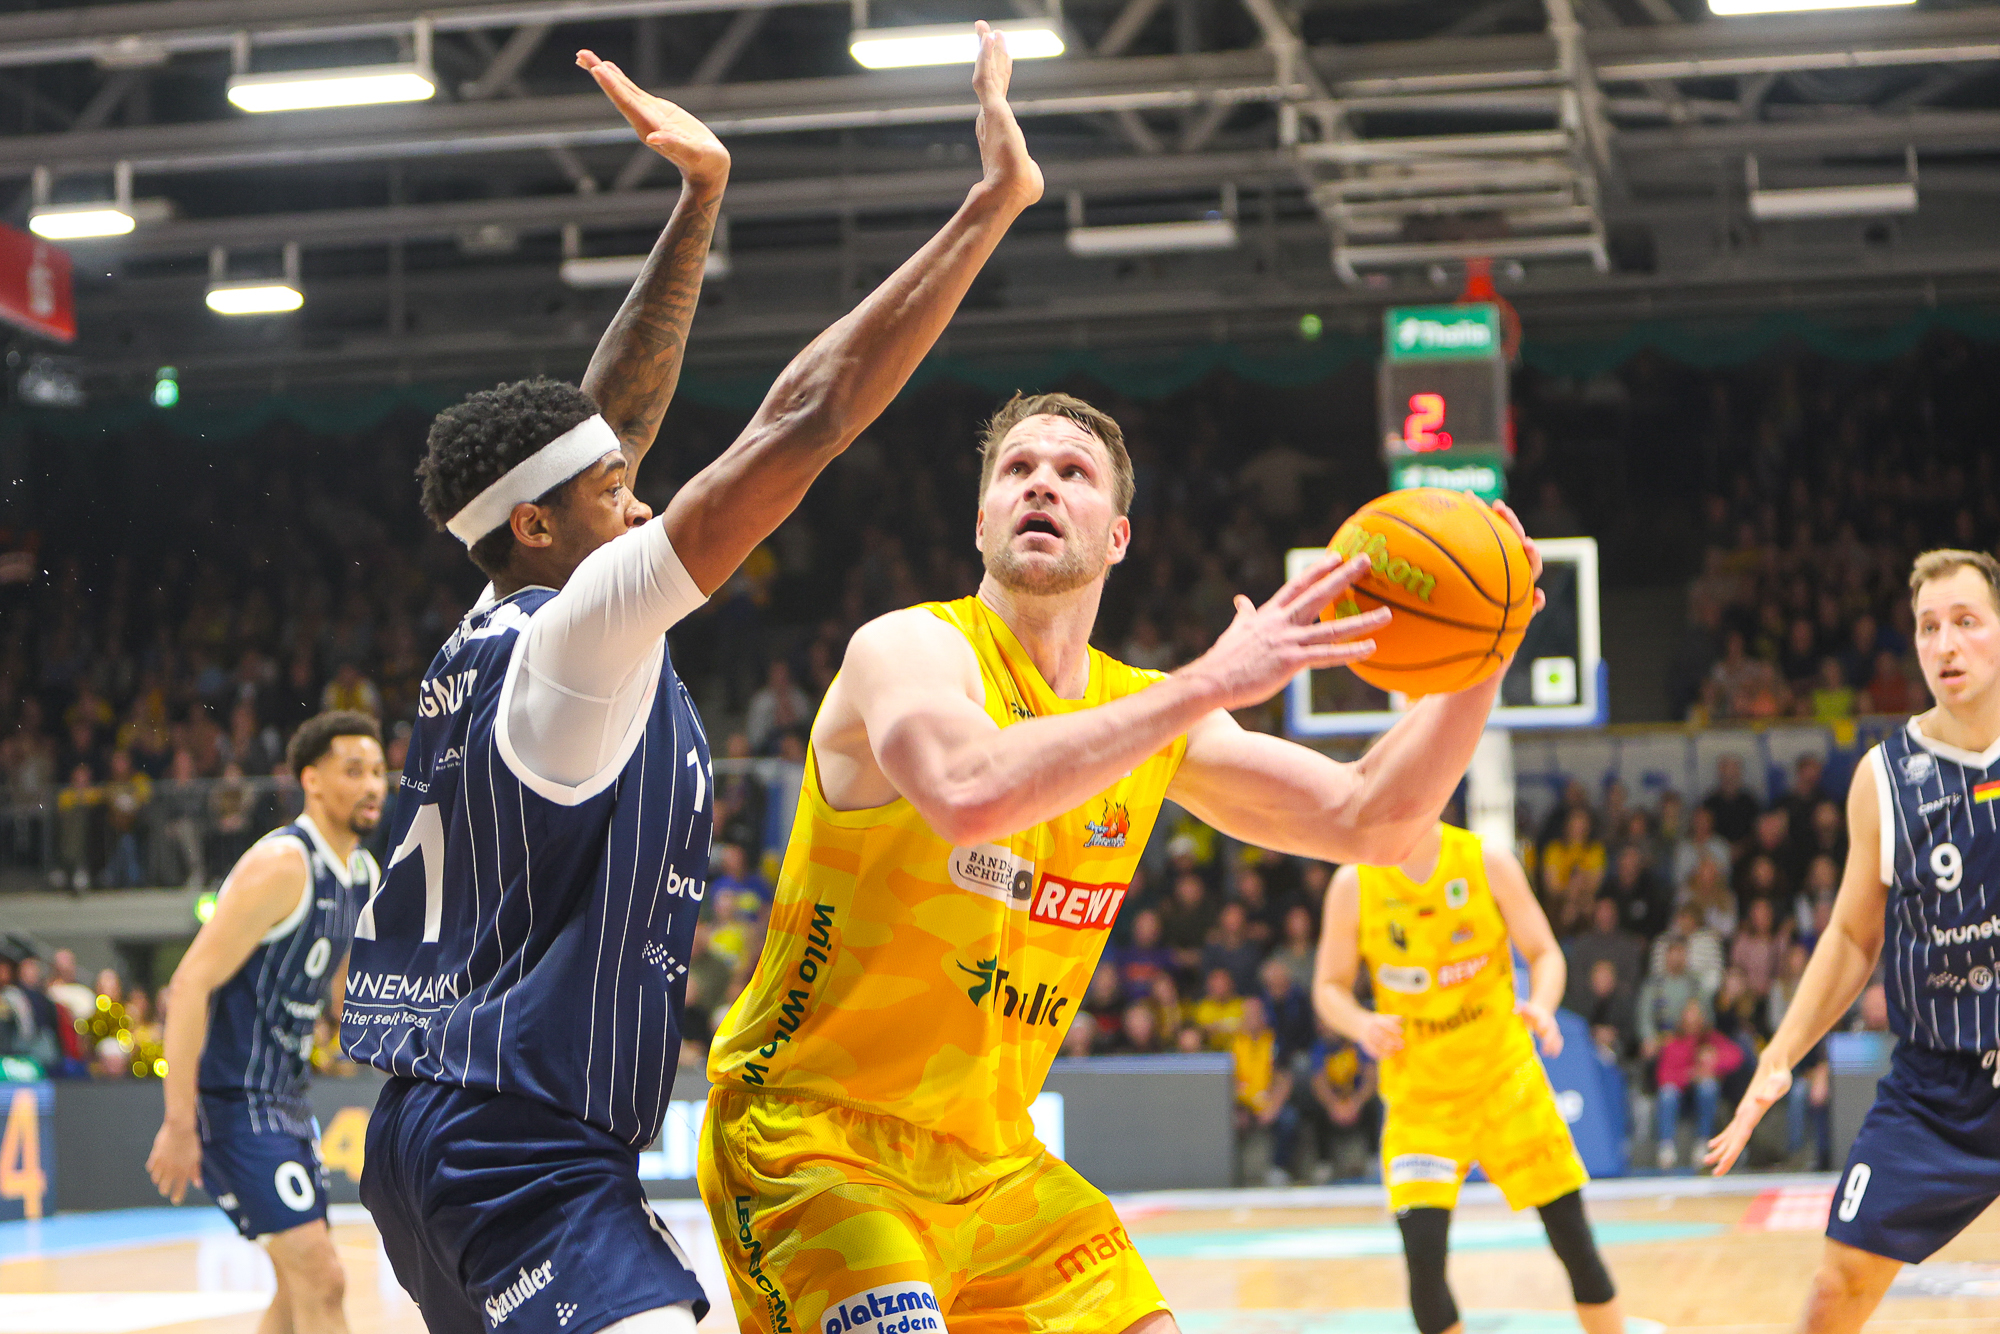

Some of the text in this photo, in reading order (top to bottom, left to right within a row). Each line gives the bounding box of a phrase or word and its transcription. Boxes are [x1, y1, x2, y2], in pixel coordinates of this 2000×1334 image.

[1929, 842, 1964, 893] 9
[304, 936, 332, 979] 0
[274, 1160, 316, 1212] 0
[1838, 1162, 1872, 1223] 9
[485, 1259, 555, 1329] Stauder
